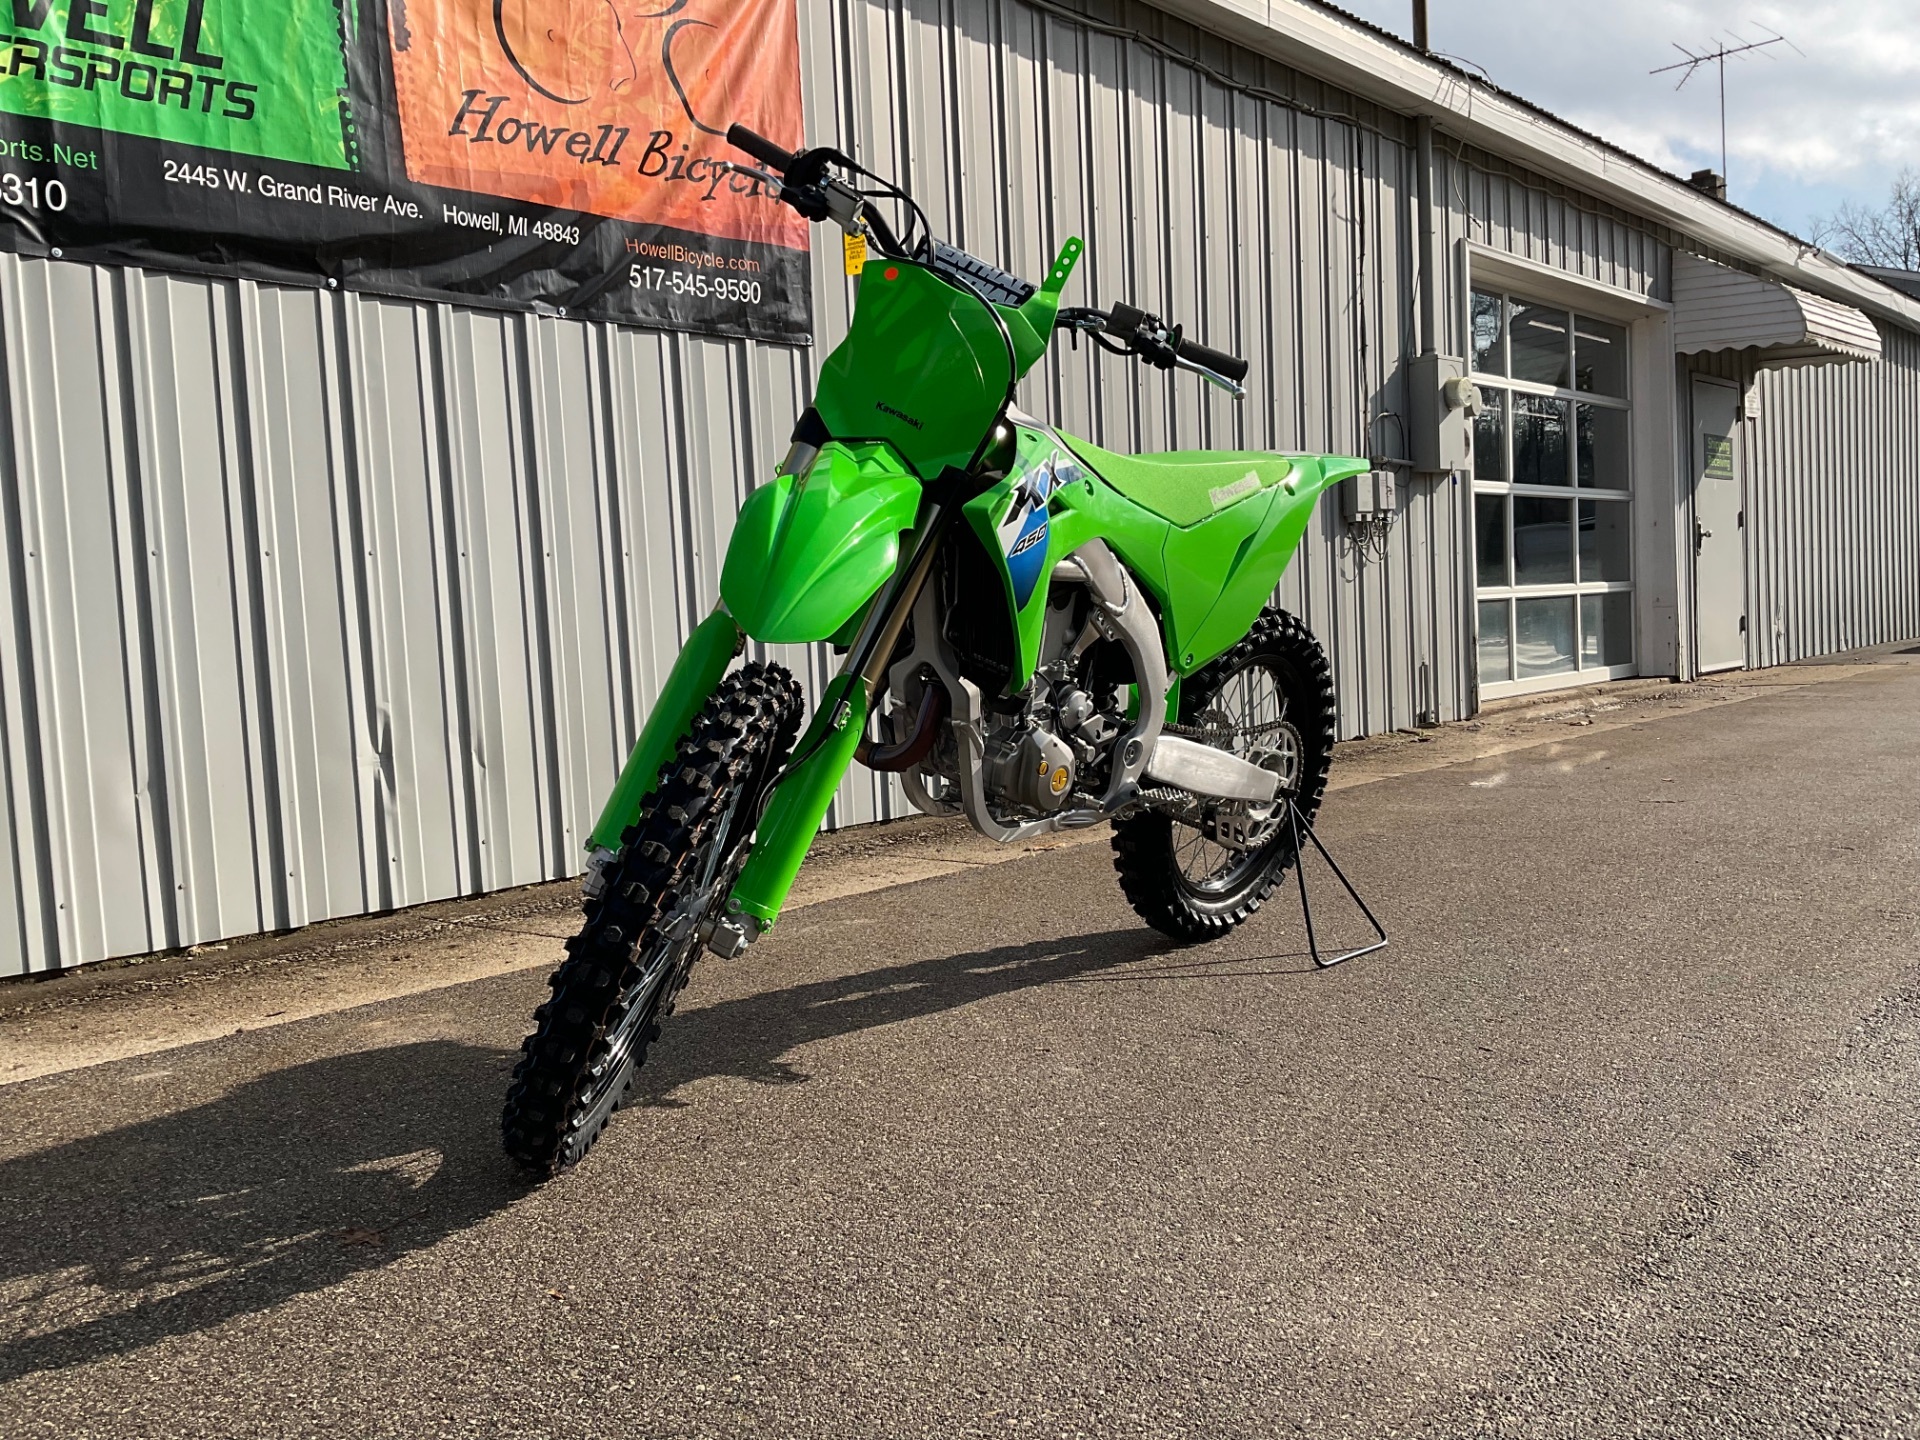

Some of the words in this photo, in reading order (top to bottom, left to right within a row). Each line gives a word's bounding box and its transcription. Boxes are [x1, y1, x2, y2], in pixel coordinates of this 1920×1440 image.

[12, 0, 223, 69] ELL
[0, 34, 257, 120] RSPORTS
[448, 89, 630, 166] Howell
[0, 139, 97, 169] orts.Net
[0, 173, 67, 211] 310
[163, 160, 220, 188] 2445
[223, 168, 252, 194] W.
[258, 175, 322, 204] Grand
[328, 185, 378, 212] River
[383, 194, 423, 219] Ave.
[443, 204, 503, 236] Howell,
[508, 215, 528, 237] MI
[532, 221, 580, 246] 48843
[625, 238, 760, 273] HowellBicycle.com
[629, 264, 762, 304] 517-545-9590
[876, 401, 924, 430] Kawasaki
[1000, 449, 1066, 528] KX
[1010, 520, 1048, 558] 450
